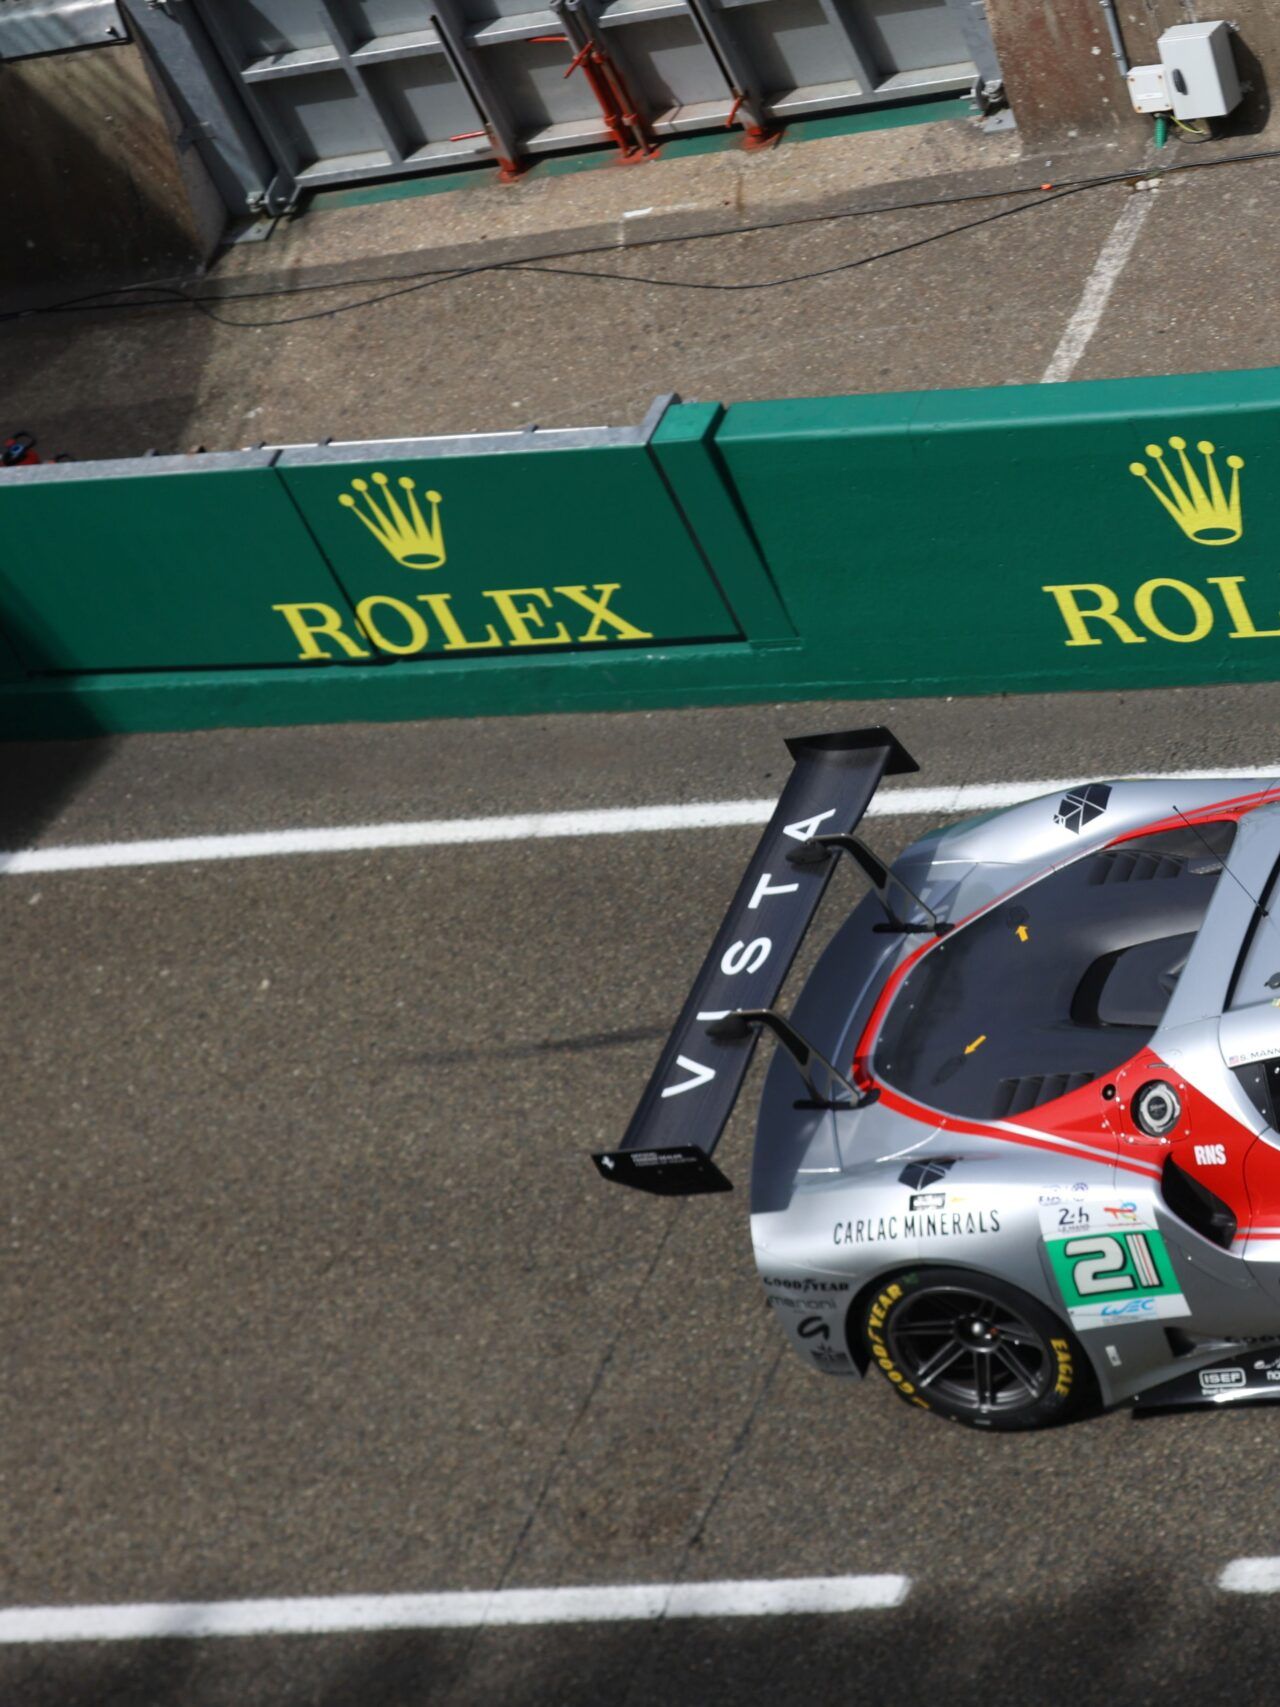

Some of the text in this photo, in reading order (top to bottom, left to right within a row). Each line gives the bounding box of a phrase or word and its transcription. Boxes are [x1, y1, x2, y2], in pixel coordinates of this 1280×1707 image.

[272, 582, 653, 662] ROLEX
[661, 808, 837, 1098] VISTA
[1193, 1143, 1227, 1166] RNS
[833, 1209, 1001, 1245] CARLAC MINERALS
[1064, 1231, 1163, 1297] 21
[1050, 1338, 1074, 1397] EAGLE
